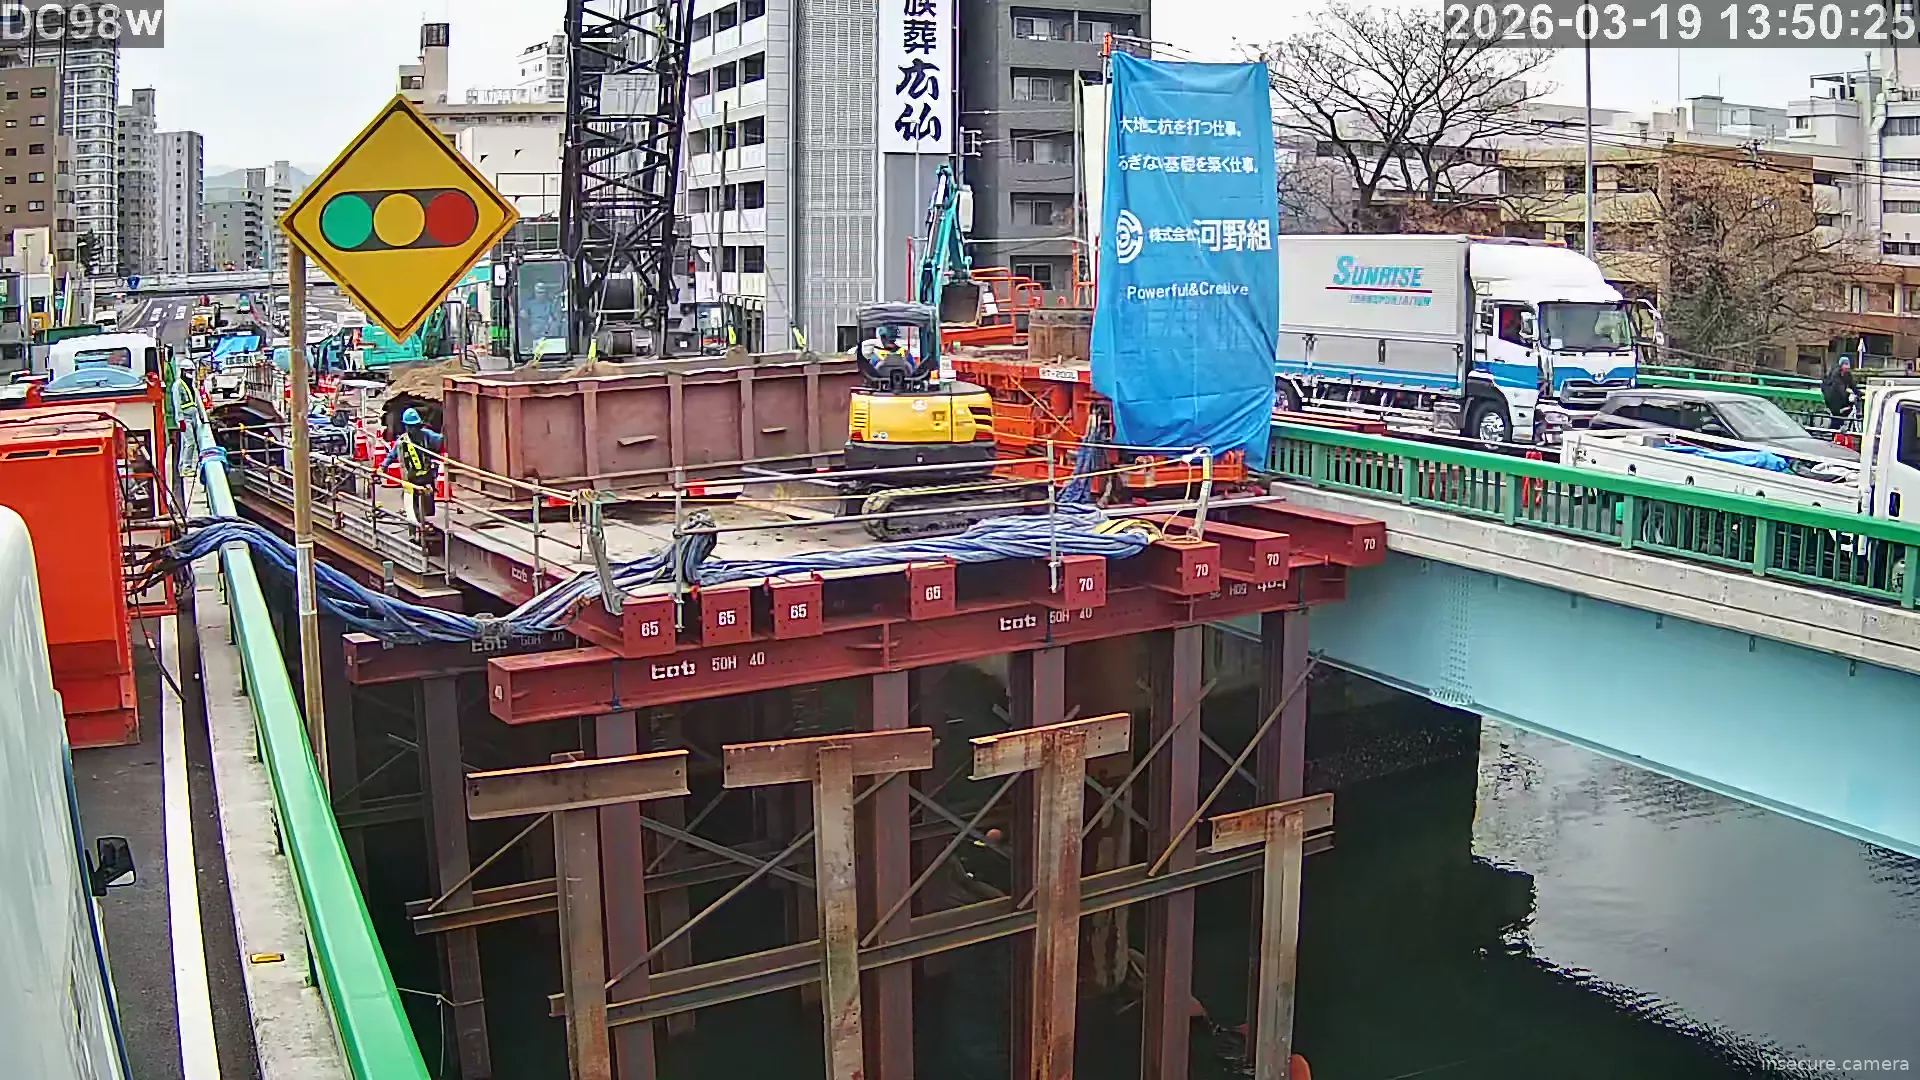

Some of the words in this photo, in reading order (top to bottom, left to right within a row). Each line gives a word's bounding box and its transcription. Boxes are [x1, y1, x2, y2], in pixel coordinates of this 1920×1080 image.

[1363, 538, 1376, 551] 70
[1267, 553, 1280, 566] 70
[1195, 563, 1208, 577] 70
[1079, 577, 1094, 592] 70
[718, 610, 735, 626] 65
[790, 604, 807, 619] 65
[641, 620, 659, 637] 65
[712, 656, 737, 672] 50H
[749, 651, 765, 667] 40
